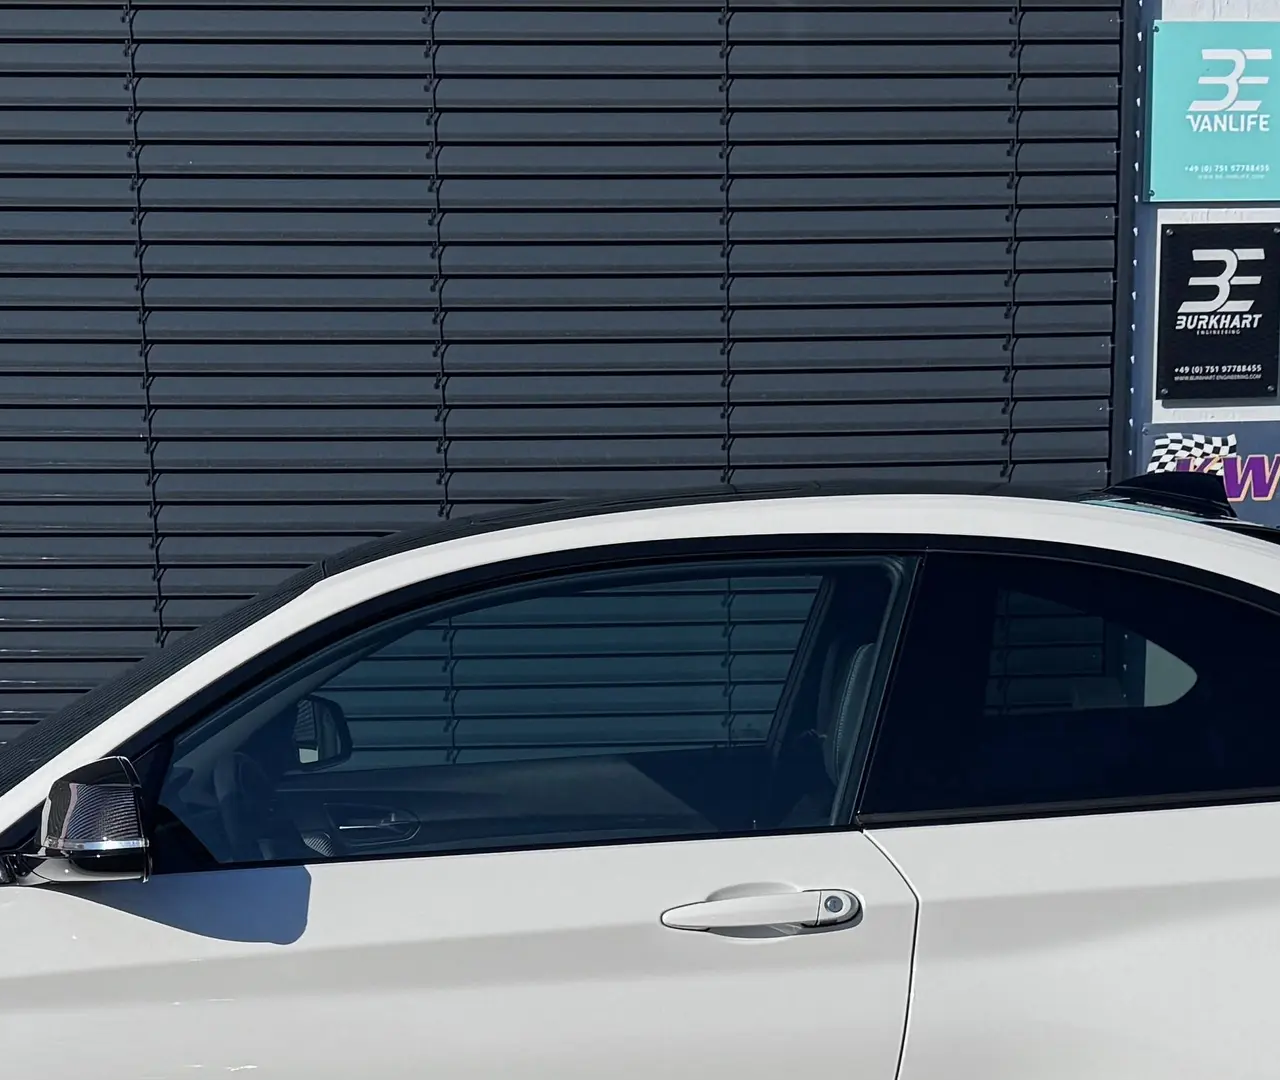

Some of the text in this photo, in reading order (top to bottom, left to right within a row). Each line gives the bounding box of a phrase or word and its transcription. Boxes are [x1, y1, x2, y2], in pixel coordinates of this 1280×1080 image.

[1185, 114, 1271, 132] VANLIFE
[1175, 313, 1263, 330] BURKHART
[1174, 366, 1190, 374] +49
[1191, 365, 1203, 374] (0)
[1205, 365, 1220, 373] 751
